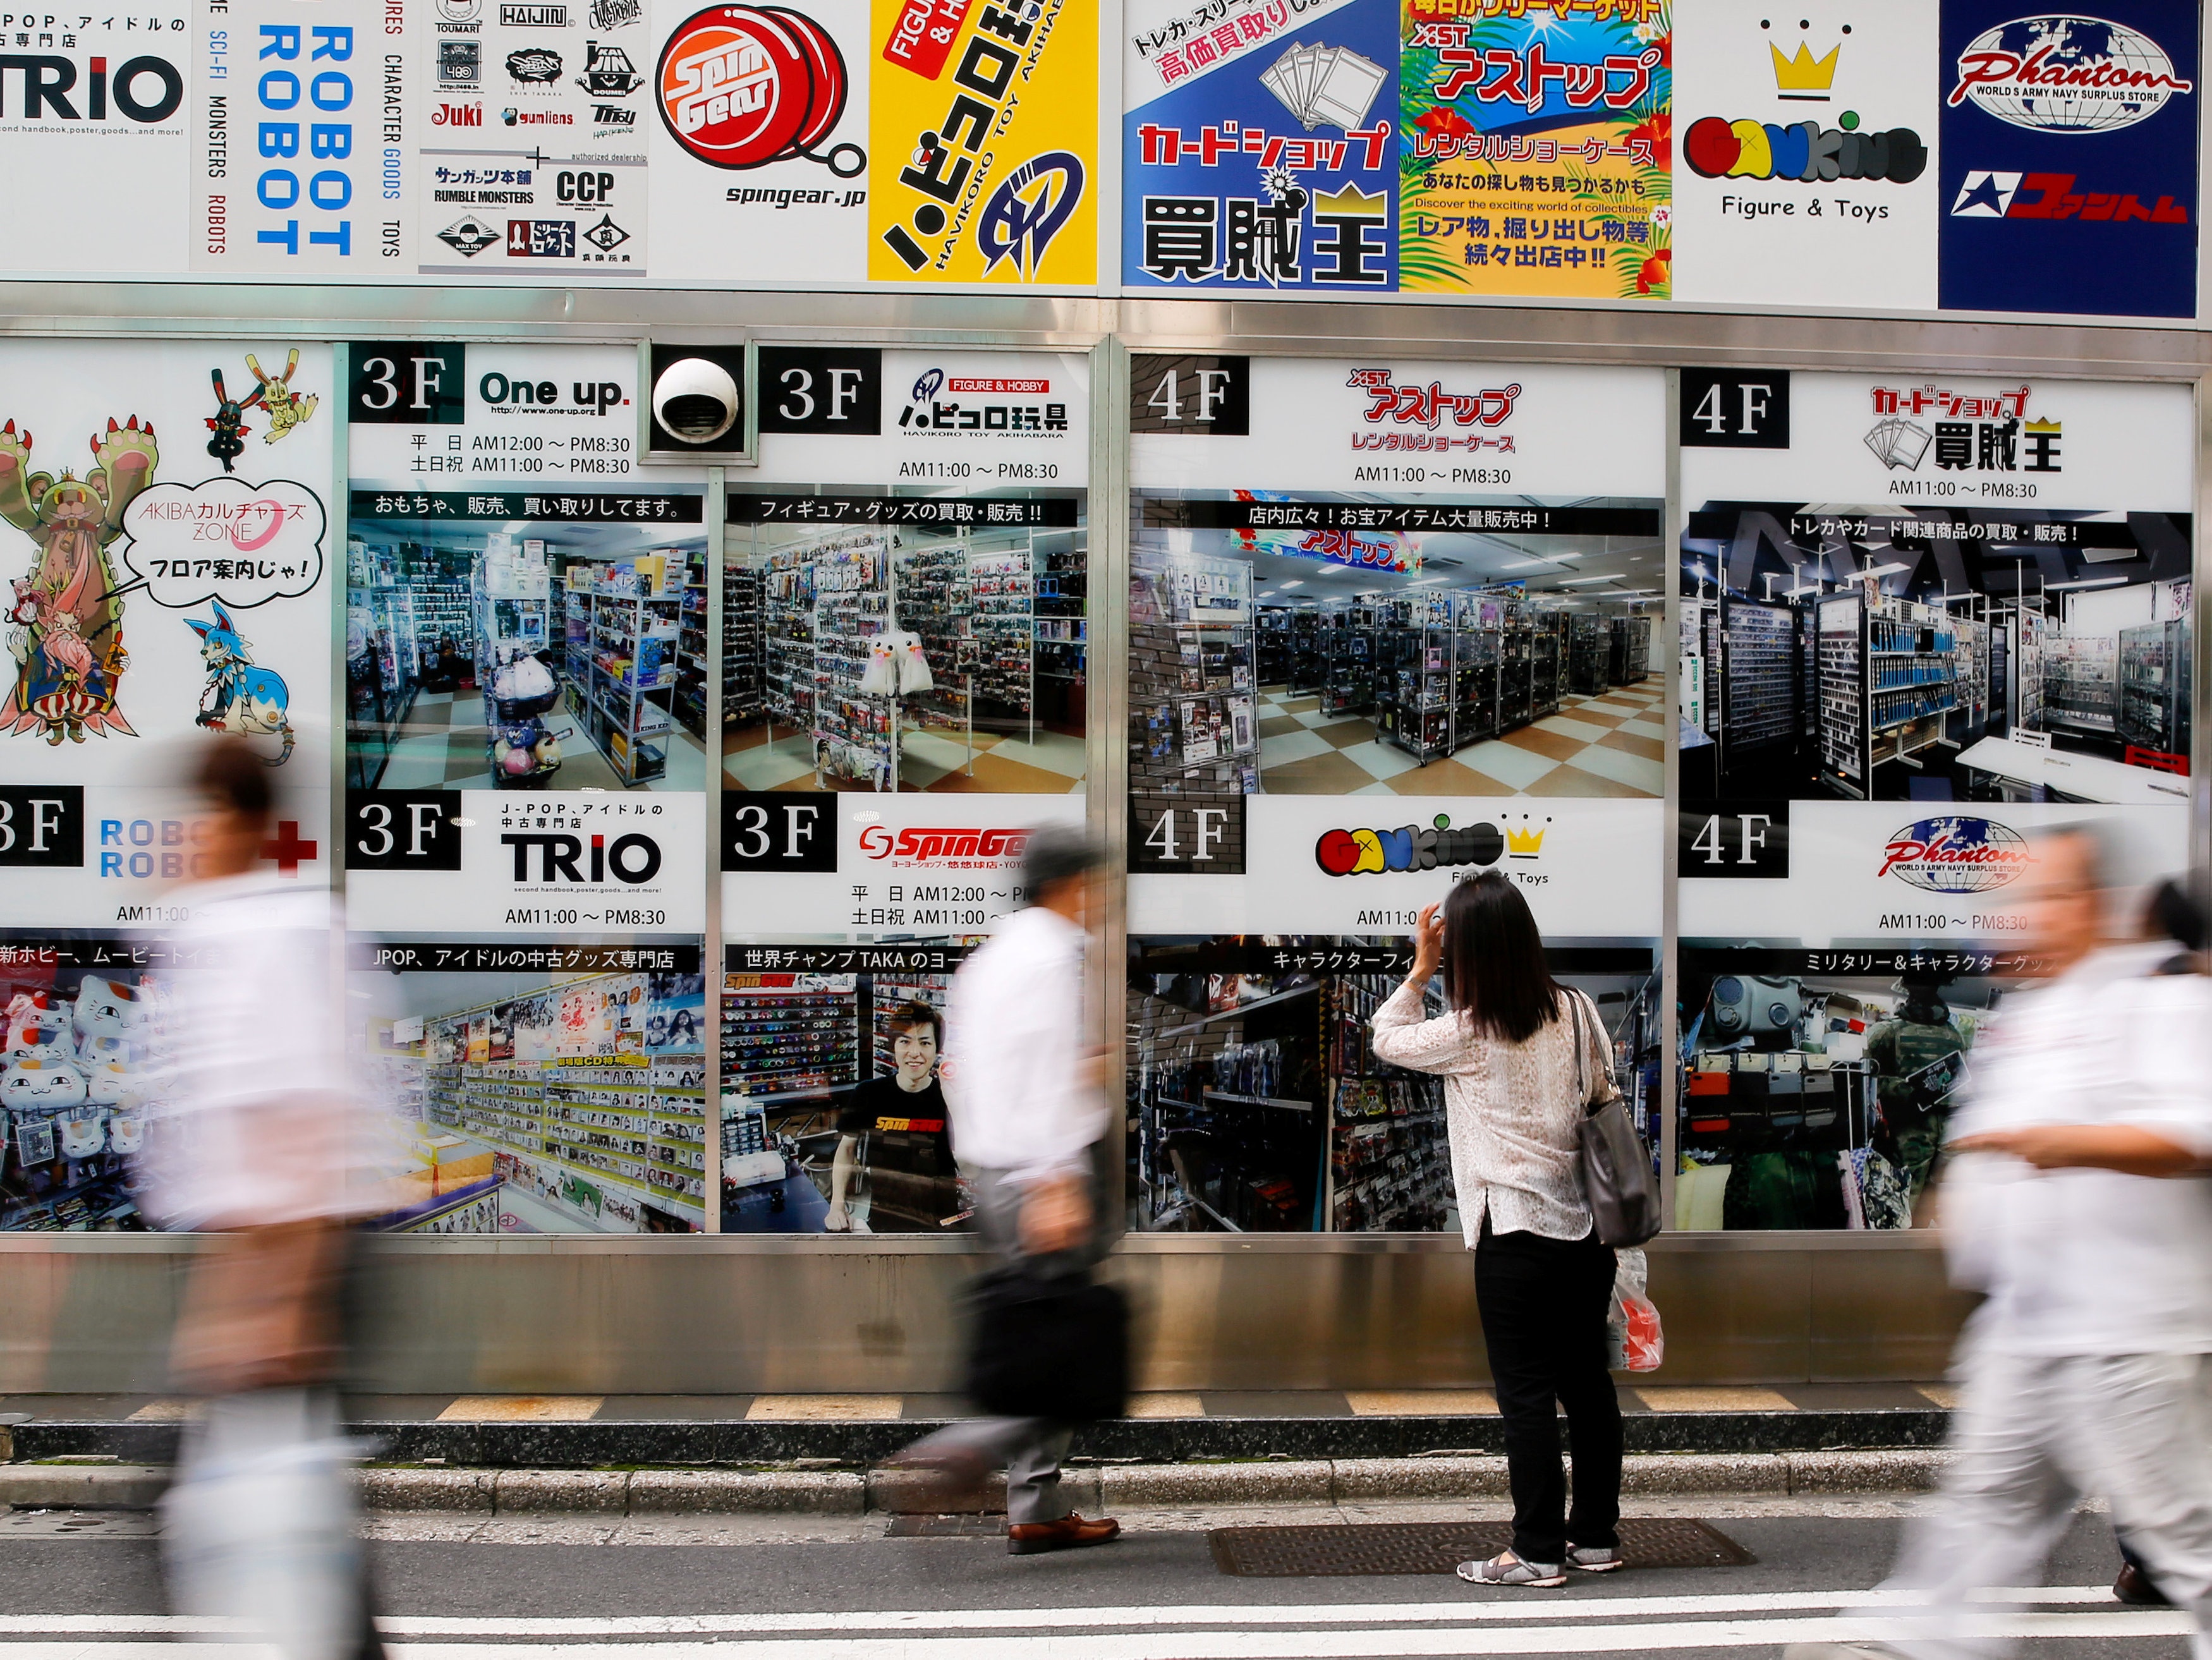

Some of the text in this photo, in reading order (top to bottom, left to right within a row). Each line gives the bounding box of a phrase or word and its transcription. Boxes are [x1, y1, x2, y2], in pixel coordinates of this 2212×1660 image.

[589, 56, 631, 72] JIN
[1434, 42, 1662, 113] アストップ
[1950, 45, 2191, 104] Phantom
[384, 54, 402, 143] CHARACTER
[1977, 86, 2011, 95] WORLD
[2022, 88, 2050, 97] ARMY
[2053, 89, 2078, 99] NAVY
[2081, 90, 2125, 100] SURPLUS
[2128, 92, 2160, 102] STORE
[208, 30, 228, 254] SCI-FI MONSTERS ROBOTS
[257, 25, 300, 255] ROBOT
[310, 25, 353, 256] ROBOT
[1139, 121, 1390, 171] カードショップ
[1413, 133, 1655, 166] レンタルショーケース
[571, 152, 647, 162] authorized dealership
[384, 149, 401, 200] GOODS
[557, 171, 614, 202] CCP
[935, 152, 994, 270] HAVIKORO
[993, 92, 1020, 138] TOY
[1422, 173, 1646, 195] あなたの探し物も見つかるかも
[435, 190, 533, 204] RUMBLE MONSTERS
[726, 188, 866, 209] spingear.jp
[1415, 198, 1648, 214] Discover the exciting world of collectibles
[1722, 196, 1889, 223] Figure & Toys
[383, 220, 400, 257] TOYS
[362, 357, 447, 409] 3F
[480, 372, 557, 406] One
[779, 368, 863, 420] 3F
[954, 380, 1044, 392] FIGURE & HOBBY
[1147, 370, 1231, 421] 4F
[1364, 381, 1521, 431] アストップ
[1692, 384, 1772, 434] 4F
[1871, 385, 2031, 420] カードショップ
[472, 437, 544, 452] AM12:00
[571, 437, 630, 452] PM8:30
[1351, 432, 1516, 453] レンタルショーケース
[410, 456, 630, 474] 土日祝 AM11:00 PM8:30
[899, 462, 1058, 478] AM11:00 PM8:30
[1354, 467, 1511, 485] AM11:00 PM8:30
[1889, 480, 2037, 498] AM11:00 PM8:30
[193, 523, 252, 541] ZONE
[358, 804, 442, 856] 3F
[501, 817, 582, 829] 中古専門店
[734, 806, 818, 857] 3F
[1145, 809, 1229, 860] 4F
[1691, 814, 1770, 864] 4F
[1878, 835, 2040, 877] Phantom
[1517, 873, 1548, 886] Toys
[913, 887, 985, 902] AM12:00
[505, 909, 665, 924] AM11:00 PM8:30
[851, 908, 985, 926] 土日祝 AM11:00
[1357, 910, 1419, 925] AM11:0
[1879, 914, 2027, 930] AM11:00 PM8:30
[373, 949, 674, 969] JPOP、アイドルの中古グッズ専門店
[745, 950, 856, 969] 世界チャンプ
[860, 952, 905, 968] TAKA
